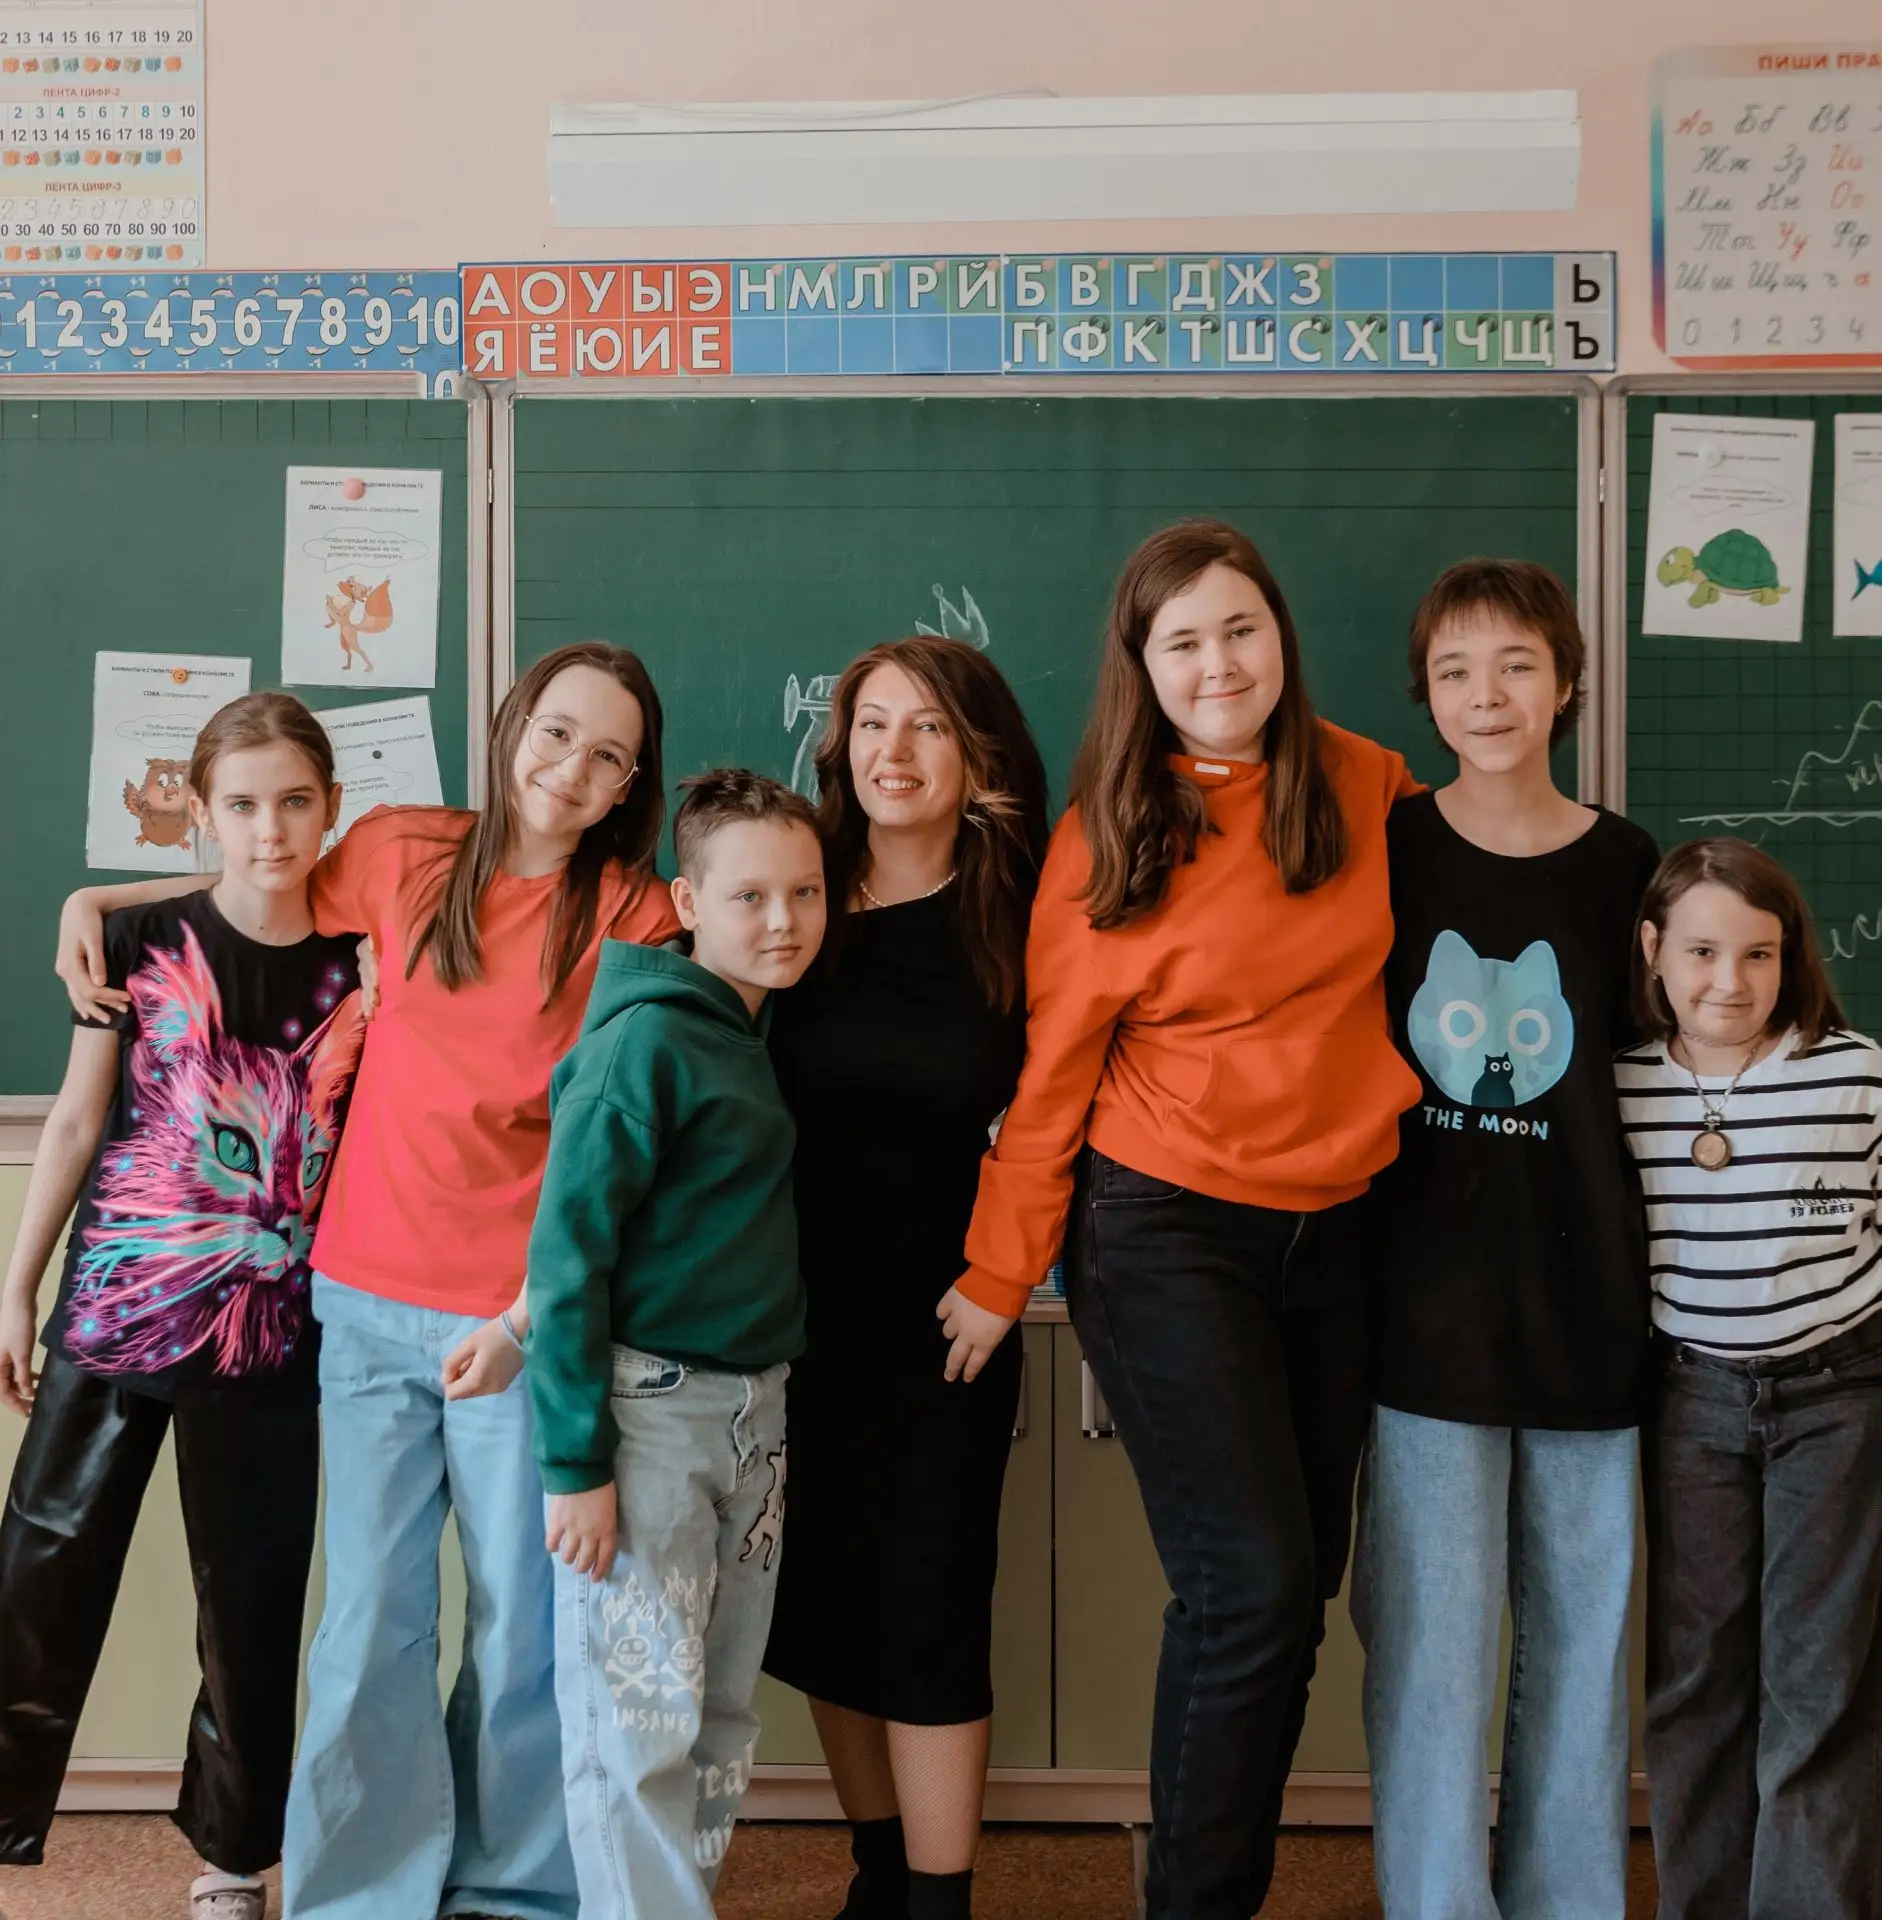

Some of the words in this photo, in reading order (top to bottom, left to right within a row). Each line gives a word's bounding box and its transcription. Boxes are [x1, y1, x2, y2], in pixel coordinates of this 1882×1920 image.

[15, 32, 31, 43] 13
[38, 32, 54, 43] 14
[61, 31, 77, 43] 15
[84, 31, 100, 43] 16
[107, 31, 123, 43] 17
[131, 31, 146, 43] 18
[154, 31, 170, 43] 19
[177, 31, 193, 42] 20
[1757, 54, 1829, 71] ПИШИ
[43, 88, 77, 97] ЛЕНТА
[81, 88, 120, 98] ЦИФР-2
[14, 105, 23, 119] 2
[36, 105, 44, 119] 3
[56, 105, 65, 119] 4
[77, 105, 86, 119] 5
[99, 105, 107, 119] 6
[120, 105, 129, 119] 7
[141, 105, 150, 119] 8
[162, 105, 170, 119] 9
[179, 105, 195, 119] 10
[11, 129, 26, 141] 12
[32, 129, 48, 141] 13
[54, 129, 69, 141] 14
[75, 129, 90, 141] 15
[96, 129, 111, 141] 16
[117, 129, 133, 141] 17
[138, 129, 153, 141] 18
[159, 129, 174, 141] 19
[180, 129, 195, 141] 20
[45, 183, 79, 192] ЛЕНТА
[82, 182, 121, 192] ЦИФР-3
[15, 224, 31, 236] 30
[38, 224, 54, 236] 40
[61, 224, 77, 236] 50
[84, 224, 99, 236] 60
[105, 224, 121, 236] 70
[128, 224, 144, 236] 80
[151, 224, 167, 236] 90
[172, 224, 196, 236] 100
[39, 277, 56, 287] +1
[85, 276, 101, 287] +1
[130, 276, 146, 286] +1
[173, 275, 190, 286] +1
[216, 275, 233, 285] +1
[262, 275, 279, 285] +1
[304, 275, 320, 285] +1
[350, 275, 367, 285] +1
[396, 275, 413, 285] +1
[468, 272, 511, 315] А
[521, 271, 566, 315] О
[578, 271, 616, 313] У
[632, 270, 676, 313] Ы
[689, 269, 722, 312] Э
[739, 269, 776, 311] Н
[787, 267, 837, 310] М
[846, 267, 884, 309] Л
[908, 265, 938, 309] Р
[958, 262, 996, 308] Й
[1016, 264, 1045, 307] Б
[1071, 264, 1100, 306] В
[1127, 264, 1156, 305] Г
[1172, 263, 1216, 312] Д
[1226, 263, 1275, 305] Ж
[1289, 263, 1321, 305] З
[1573, 264, 1600, 303] Ь
[16, 302, 36, 348] 1
[56, 301, 83, 348] 2
[100, 300, 128, 348] 3
[144, 299, 173, 347] 4
[189, 299, 218, 347] 5
[233, 298, 261, 347] 6
[275, 298, 304, 346] 7
[320, 297, 347, 346] 8
[364, 297, 392, 346] 9
[407, 296, 458, 346] 10
[1682, 318, 1702, 346] 0
[1730, 317, 1742, 345] 1
[1766, 315, 1782, 344] 2
[1805, 315, 1825, 345] 3
[1847, 316, 1866, 342] 4
[473, 329, 504, 372] Я
[530, 323, 557, 371] Ё
[576, 328, 623, 371] Ю
[632, 327, 671, 370] И
[692, 326, 720, 369] Е
[1013, 321, 1047, 363] П
[1062, 320, 1107, 362] Ф
[1124, 321, 1159, 363] К
[1180, 320, 1212, 362] Т
[1227, 320, 1274, 363] Ш
[1288, 320, 1322, 362] С
[1343, 320, 1379, 362] Х
[1399, 320, 1438, 366] Ц
[1454, 320, 1487, 361] Ч
[1503, 319, 1553, 366] Щ
[1565, 321, 1599, 359] Ъ
[0, 361, 12, 371] -1
[44, 361, 57, 370] -1
[89, 360, 101, 370] -1
[133, 360, 146, 370] -1
[177, 359, 190, 369] -1
[220, 359, 233, 369] -1
[266, 358, 279, 368] -1
[308, 358, 321, 368] -1
[354, 358, 366, 368] -1
[401, 358, 414, 368] -1
[1424, 1106, 1464, 1130] THE
[1479, 1114, 1549, 1140] MOON
[612, 1706, 692, 1734] INSANE
